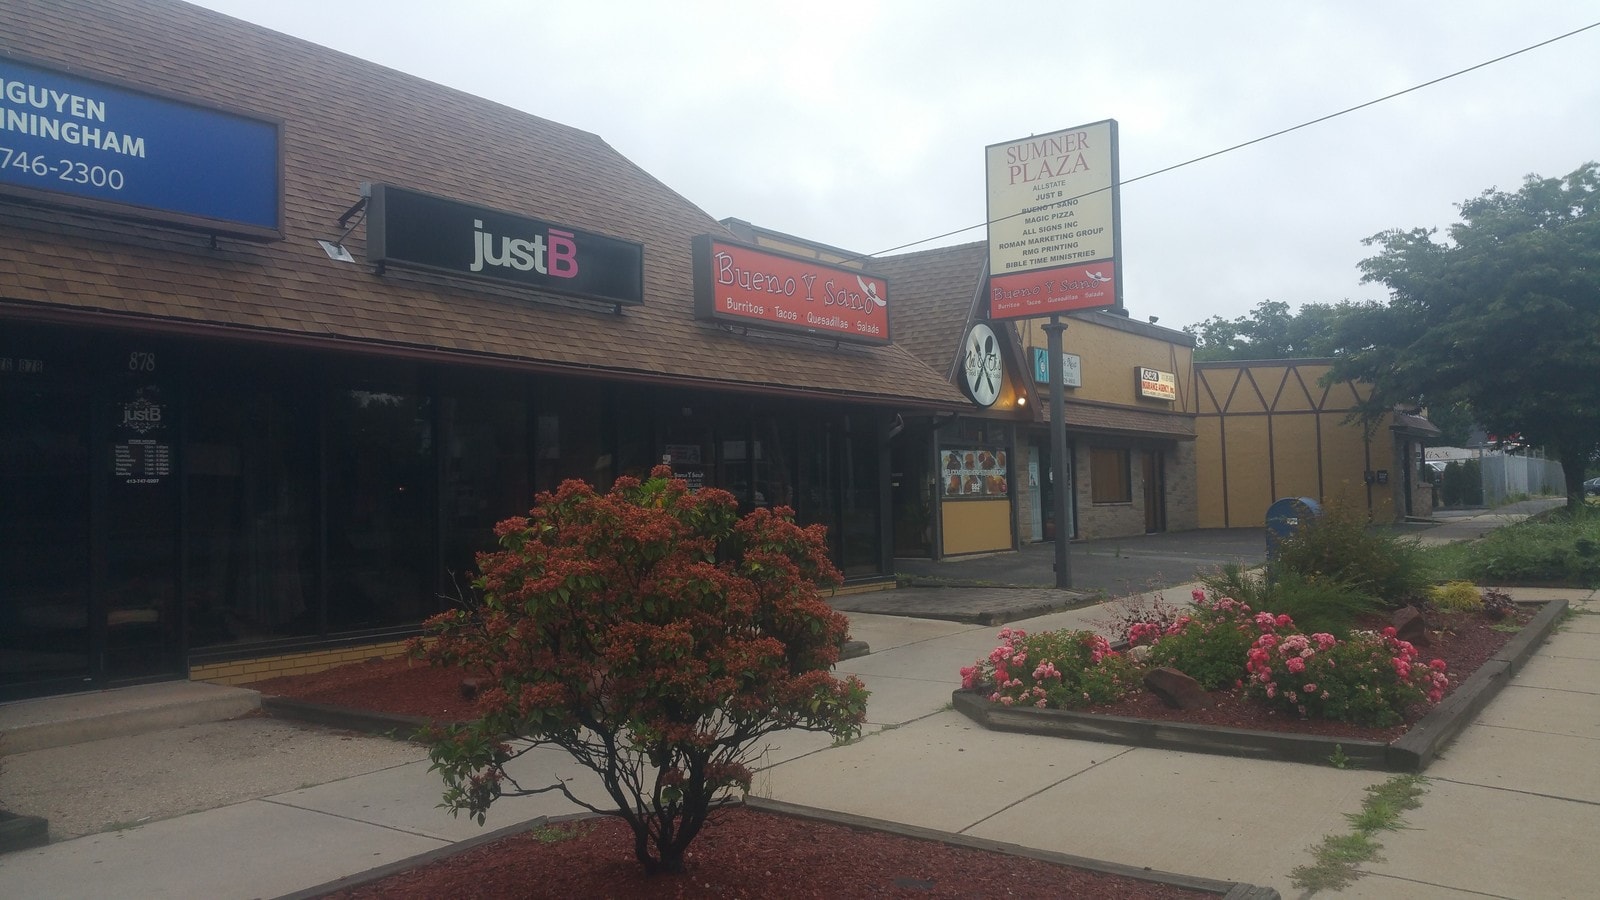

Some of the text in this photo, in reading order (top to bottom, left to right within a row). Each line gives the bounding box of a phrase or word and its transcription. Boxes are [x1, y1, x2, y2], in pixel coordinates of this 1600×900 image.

[0, 78, 106, 123] GUYEN
[0, 107, 146, 159] NINGHAM
[1007, 131, 1090, 165] SUMNER
[1009, 152, 1090, 186] PLAZA
[1032, 180, 1067, 192] ALLSTATE
[1035, 190, 1063, 201] JUST B
[1021, 199, 1079, 214] BUENO Y SANO
[1024, 210, 1075, 225] MAGIC PIZZA
[1022, 221, 1078, 236] ALL SIGNS INC
[999, 227, 1104, 250] ROMAN MARKETING GROUP
[1022, 242, 1079, 256] RMG PRINTING
[1005, 250, 1096, 269] BIBLE TIME MINISTRIES
[715, 251, 874, 315] Bueno Y Sano
[993, 278, 1100, 301] Bueno Y Sano
[727, 297, 880, 334] Burritos Tacos Quesadillas Salads
[129, 352, 155, 371] 878
[122, 405, 161, 423] justB
